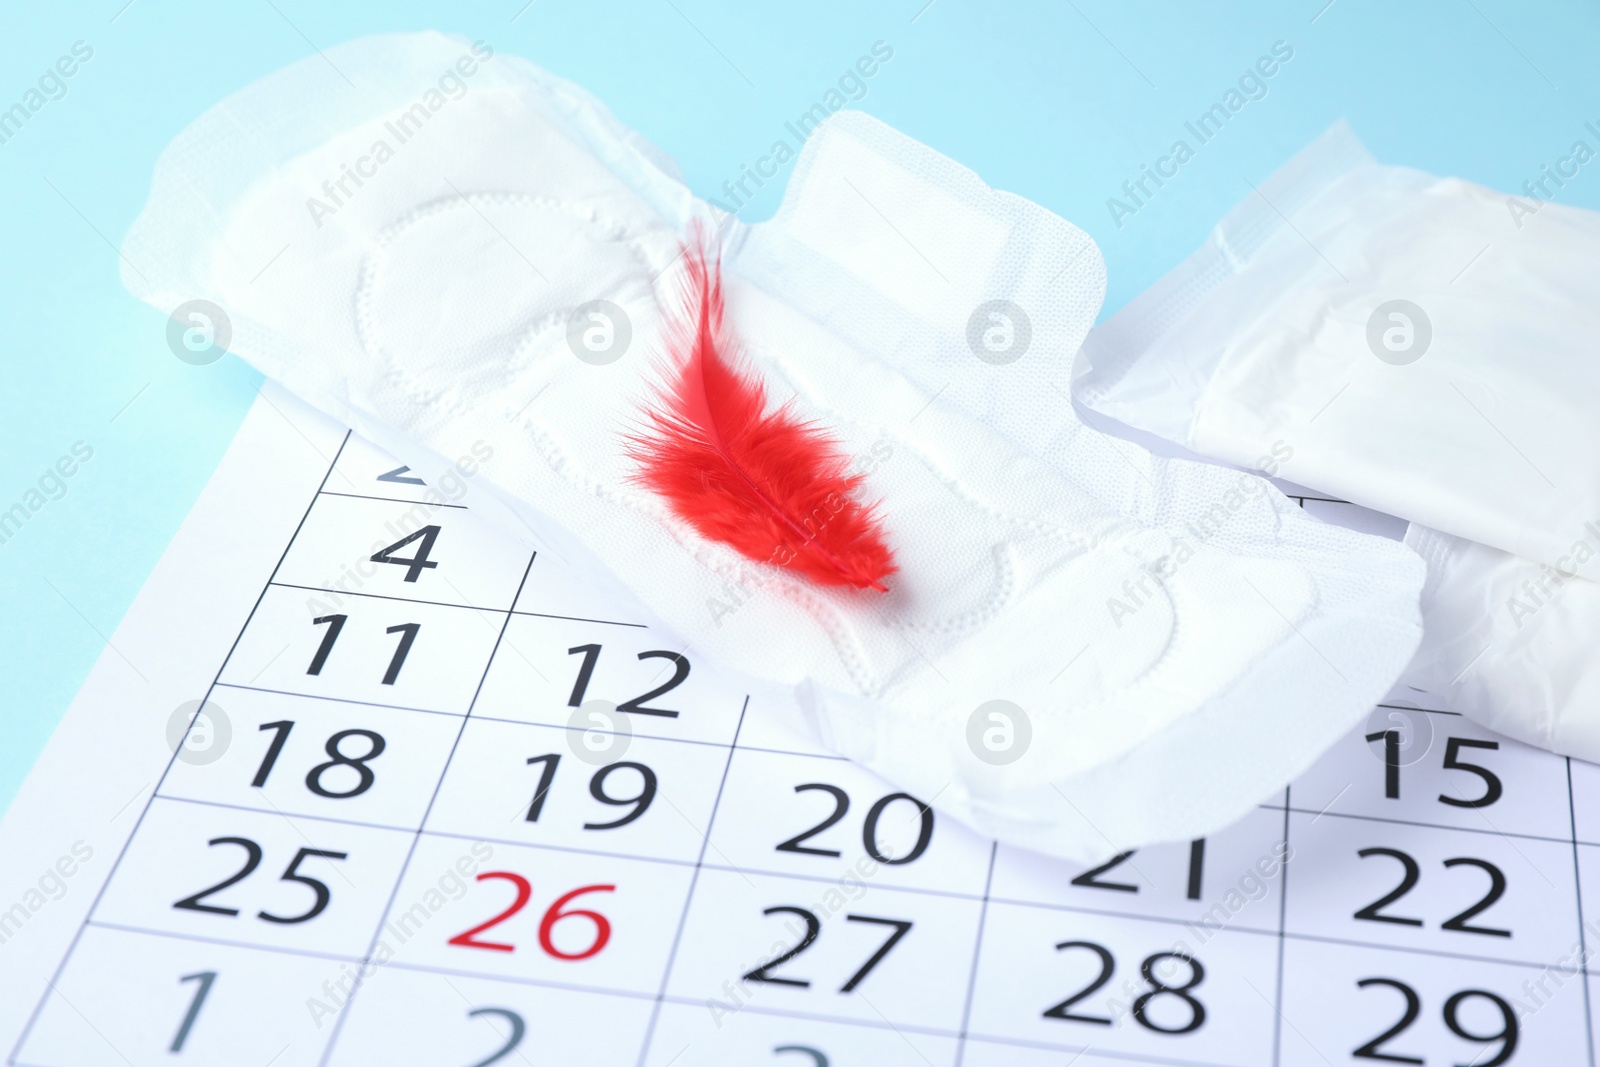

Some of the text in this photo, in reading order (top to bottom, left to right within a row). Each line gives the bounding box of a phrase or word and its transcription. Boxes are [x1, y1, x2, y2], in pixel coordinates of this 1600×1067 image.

[369, 525, 442, 583] 4
[306, 614, 421, 685] 11
[567, 643, 691, 718] 12
[251, 719, 386, 798] 18
[525, 753, 658, 830] 19
[1364, 730, 1503, 809] 15
[775, 783, 935, 865] 20
[173, 837, 347, 926] 25
[448, 871, 617, 962] 26
[1353, 847, 1512, 939] 22
[741, 905, 914, 993] 27
[1042, 941, 1207, 1035] 28
[170, 971, 217, 1053] 1
[1351, 977, 1520, 1067] 29
